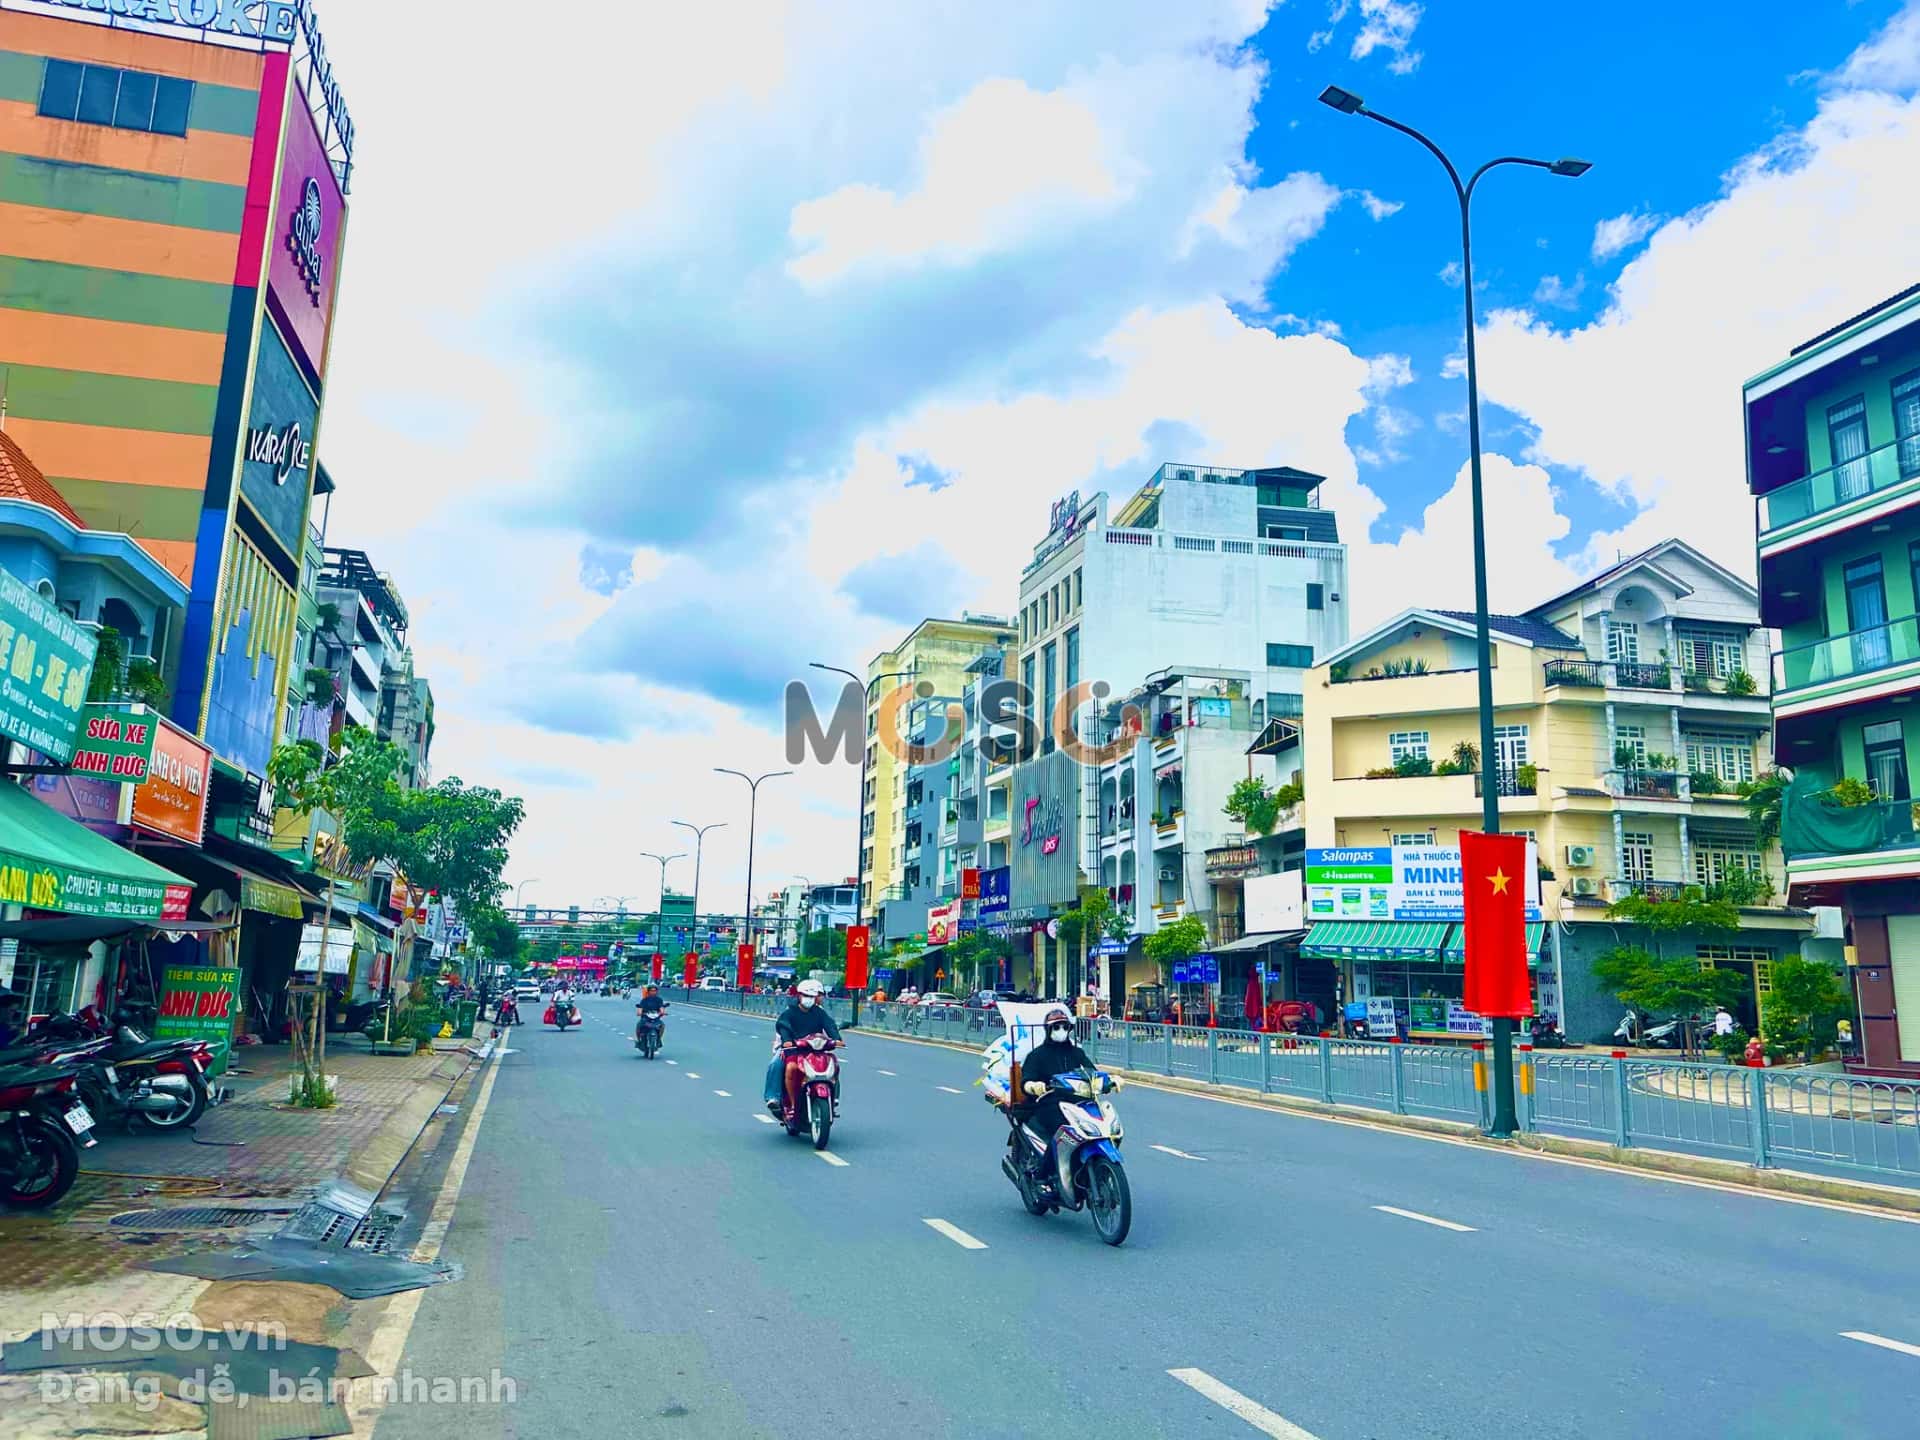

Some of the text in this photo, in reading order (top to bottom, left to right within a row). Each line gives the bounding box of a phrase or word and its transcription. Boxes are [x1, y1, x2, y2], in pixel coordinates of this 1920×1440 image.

[249, 422, 310, 486] KARAOKE
[42, 652, 68, 702] XE
[87, 713, 147, 744] SỬA XE
[72, 751, 146, 777] ANH ĐỨC
[1321, 850, 1374, 863] Salonpas
[66, 875, 102, 897] CHUYÊN
[1404, 867, 1463, 884] MINH
[221, 972, 235, 983] XE
[159, 984, 234, 1018] ANH ĐỨC
